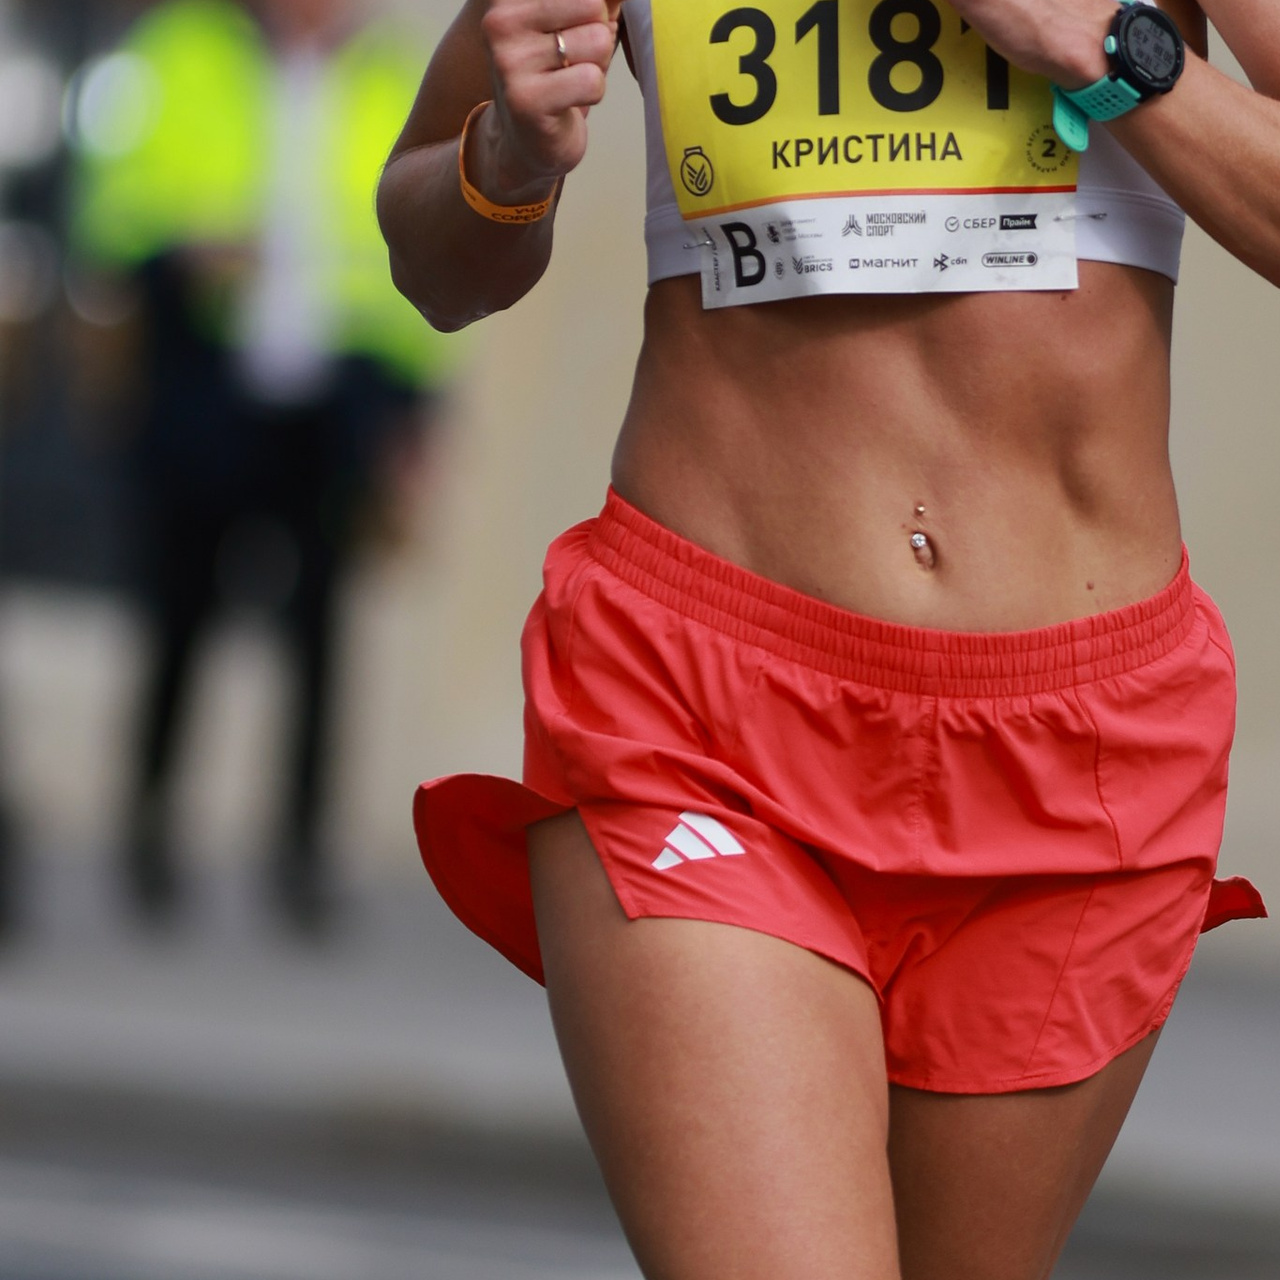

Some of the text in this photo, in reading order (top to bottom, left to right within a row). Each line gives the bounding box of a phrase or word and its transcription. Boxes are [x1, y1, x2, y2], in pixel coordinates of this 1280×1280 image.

[771, 131, 963, 170] КРИСТИНА
[1041, 139, 1056, 157] 2
[866, 210, 926, 225] МОСКОВСКИЙ
[963, 218, 1031, 229] СБЕР Прайм
[866, 225, 894, 237] СПОРТ
[985, 255, 1025, 265] WINLINE
[804, 262, 833, 274] BRICS
